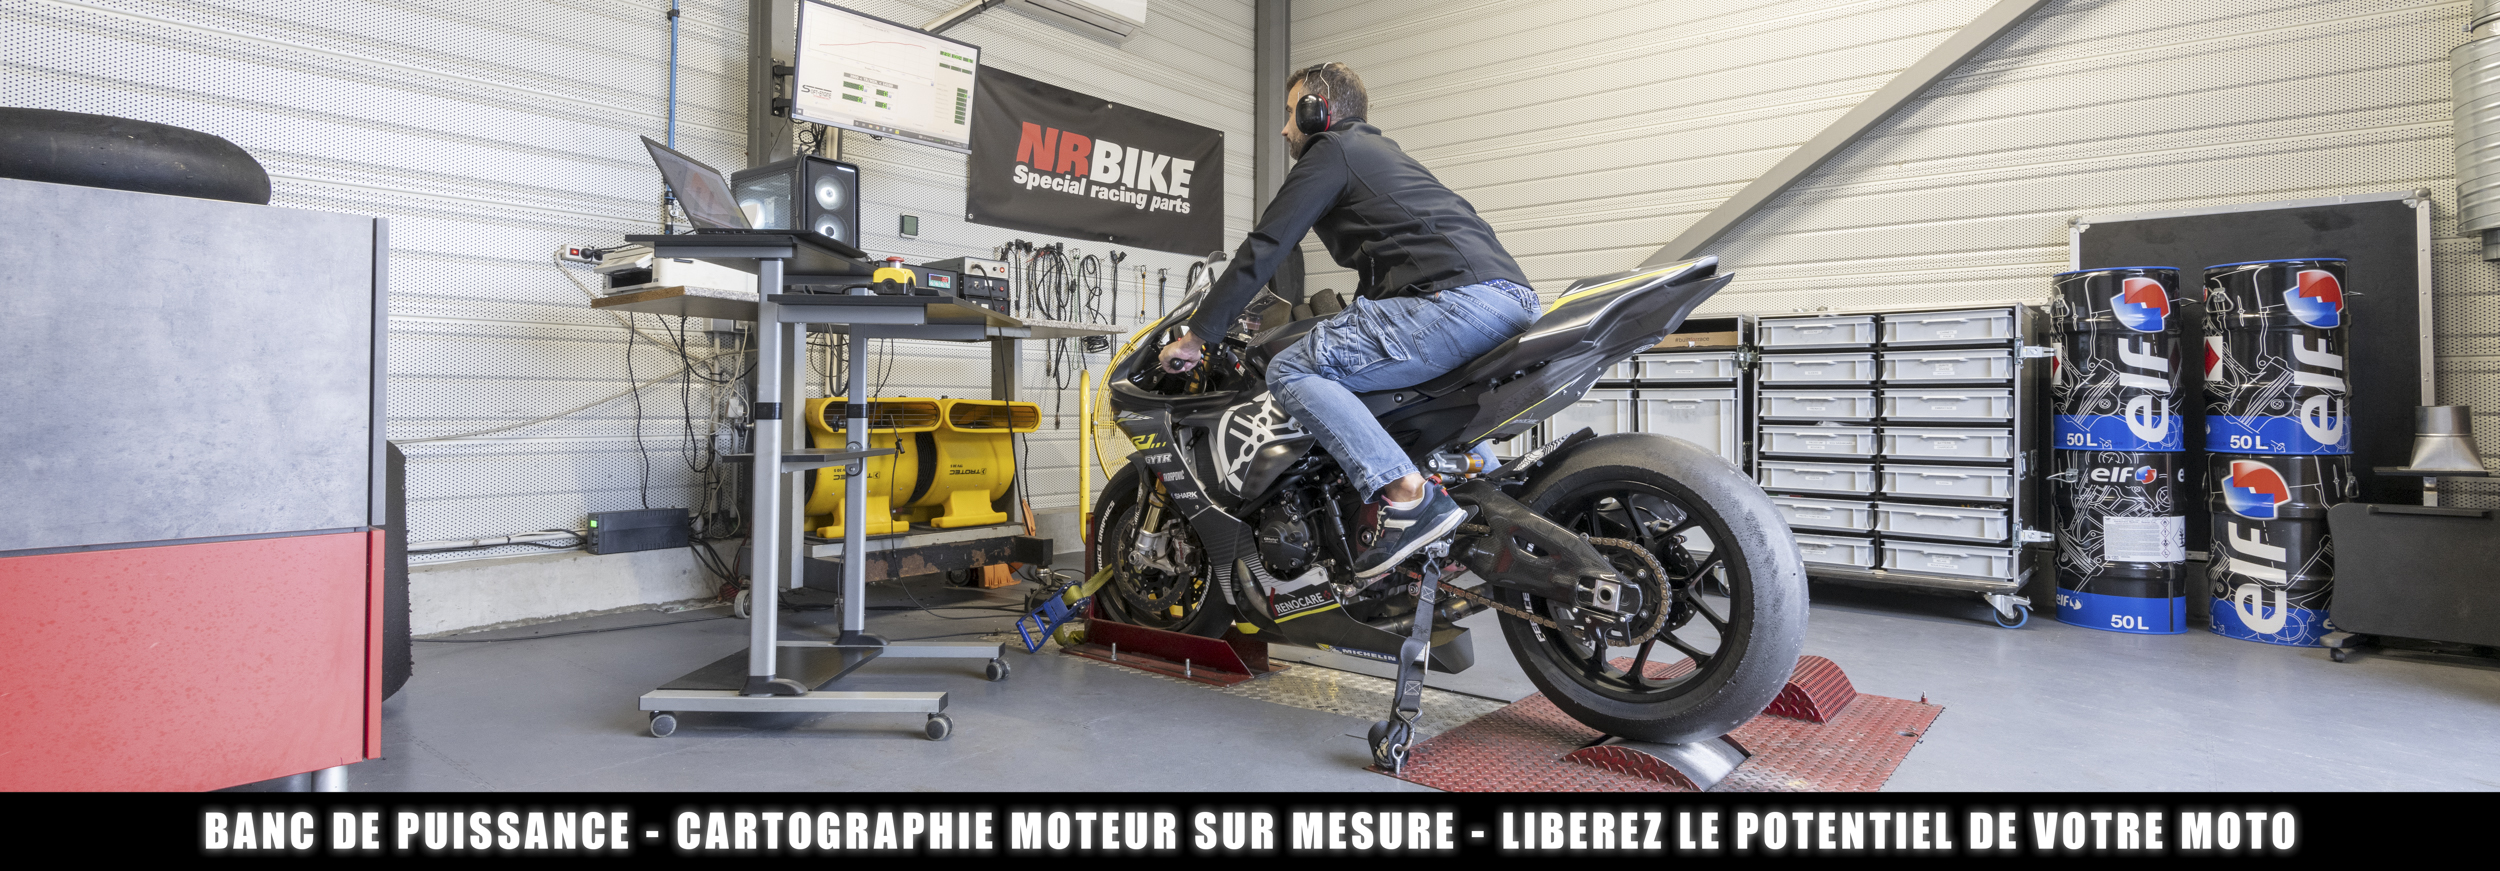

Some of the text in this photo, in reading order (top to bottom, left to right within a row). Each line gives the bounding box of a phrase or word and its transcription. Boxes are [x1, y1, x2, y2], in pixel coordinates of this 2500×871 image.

[1013, 164, 1191, 214] Special racing parts
[2118, 337, 2171, 443] elf
[2292, 333, 2346, 445] elf
[2066, 433, 2098, 446] 50 L
[2229, 435, 2269, 450] 50 L
[1145, 452, 1173, 465] GYTR
[2090, 466, 2134, 483] elf
[1174, 490, 1198, 500] SHARK
[2227, 521, 2287, 634] elf
[1275, 592, 1325, 614] RENOCARE
[2110, 614, 2149, 630] 50 L
[1341, 648, 1397, 662] MICHELIN
